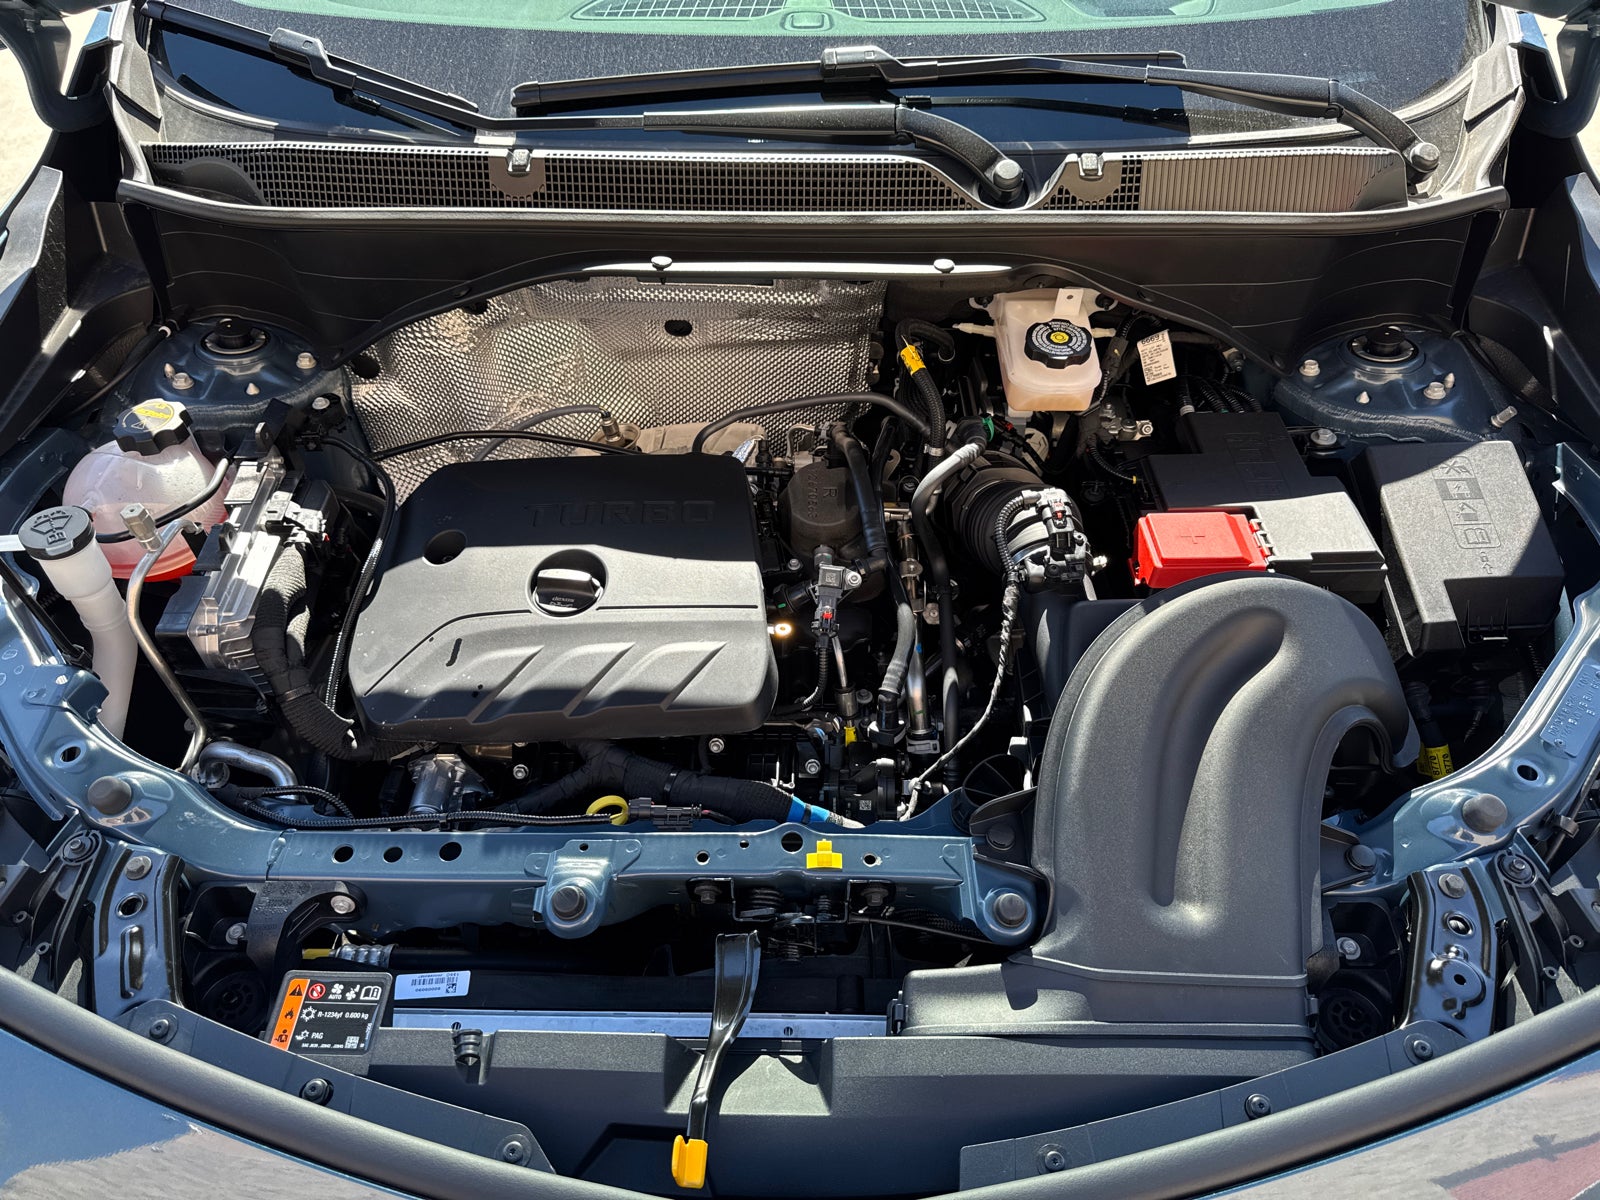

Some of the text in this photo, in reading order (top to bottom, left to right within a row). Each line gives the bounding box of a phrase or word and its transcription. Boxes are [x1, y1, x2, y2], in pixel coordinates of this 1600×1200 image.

[520, 500, 716, 528] TURBO
[1430, 755, 1440, 776] 8770
[317, 1011, 343, 1020] R-1234yf
[361, 1012, 369, 1020] kg
